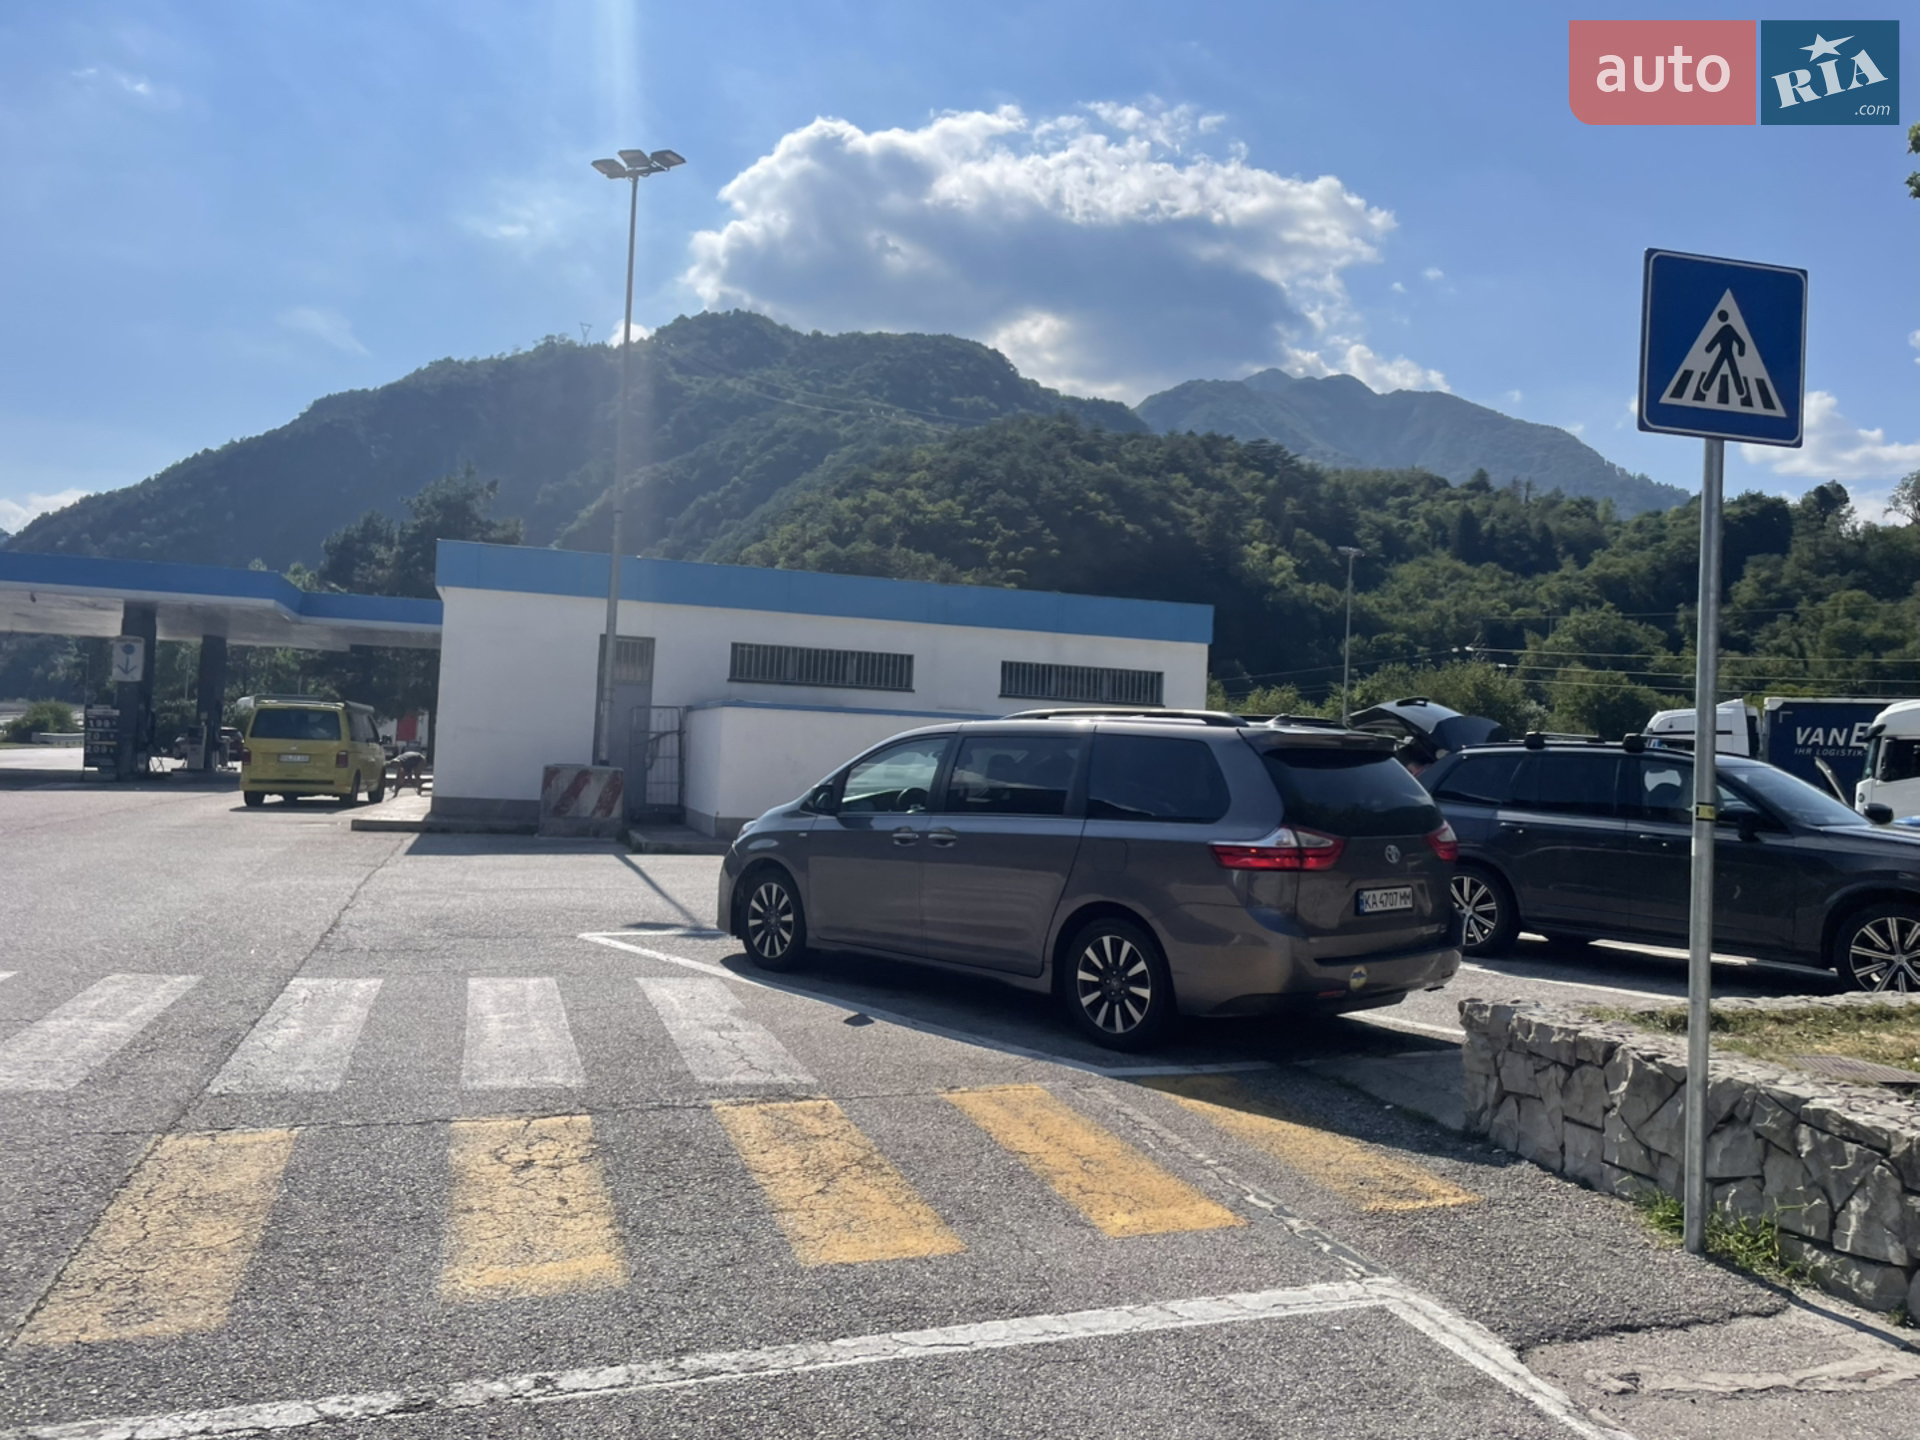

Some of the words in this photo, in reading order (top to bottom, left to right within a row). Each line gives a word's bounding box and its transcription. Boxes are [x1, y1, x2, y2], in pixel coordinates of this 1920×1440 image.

[1794, 747, 1812, 755] IHR
[1364, 893, 1378, 909] KA
[1379, 891, 1398, 907] 4707
